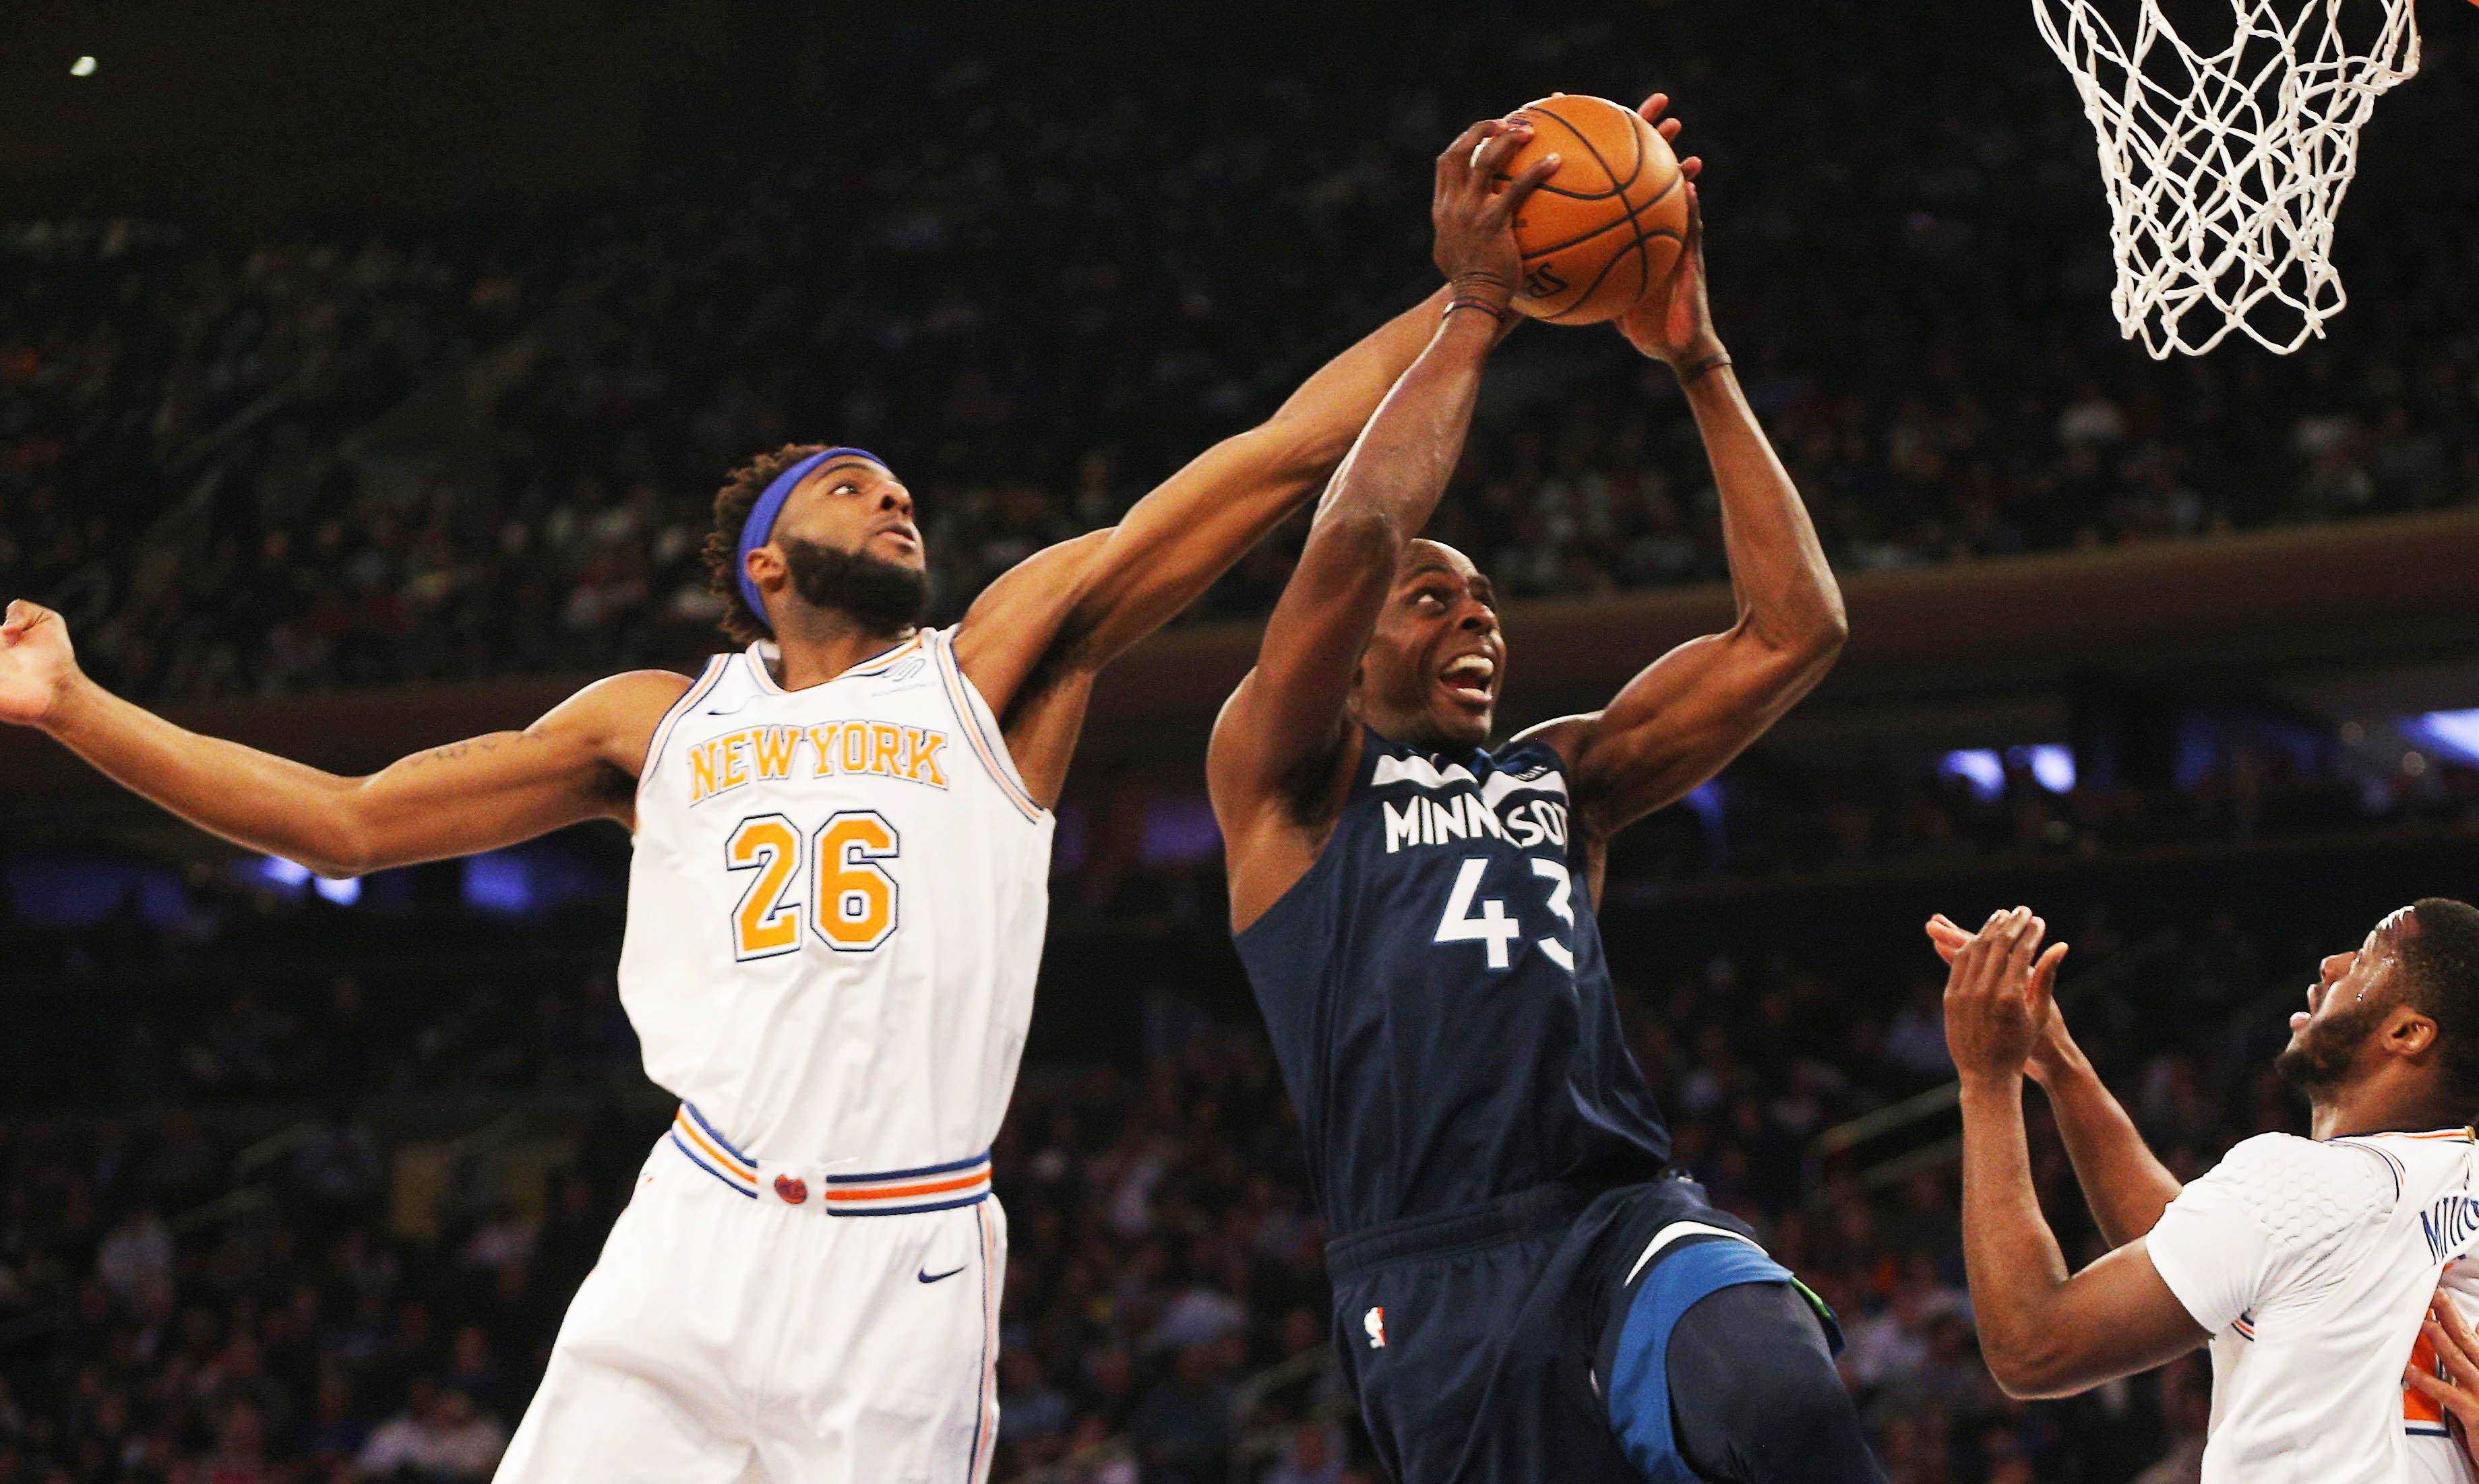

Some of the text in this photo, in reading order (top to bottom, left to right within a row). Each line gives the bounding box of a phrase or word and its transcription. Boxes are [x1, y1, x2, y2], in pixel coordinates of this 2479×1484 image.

[687, 719, 948, 807] NEW YORK
[725, 809, 900, 962] 26
[1434, 857, 1575, 969] 43
